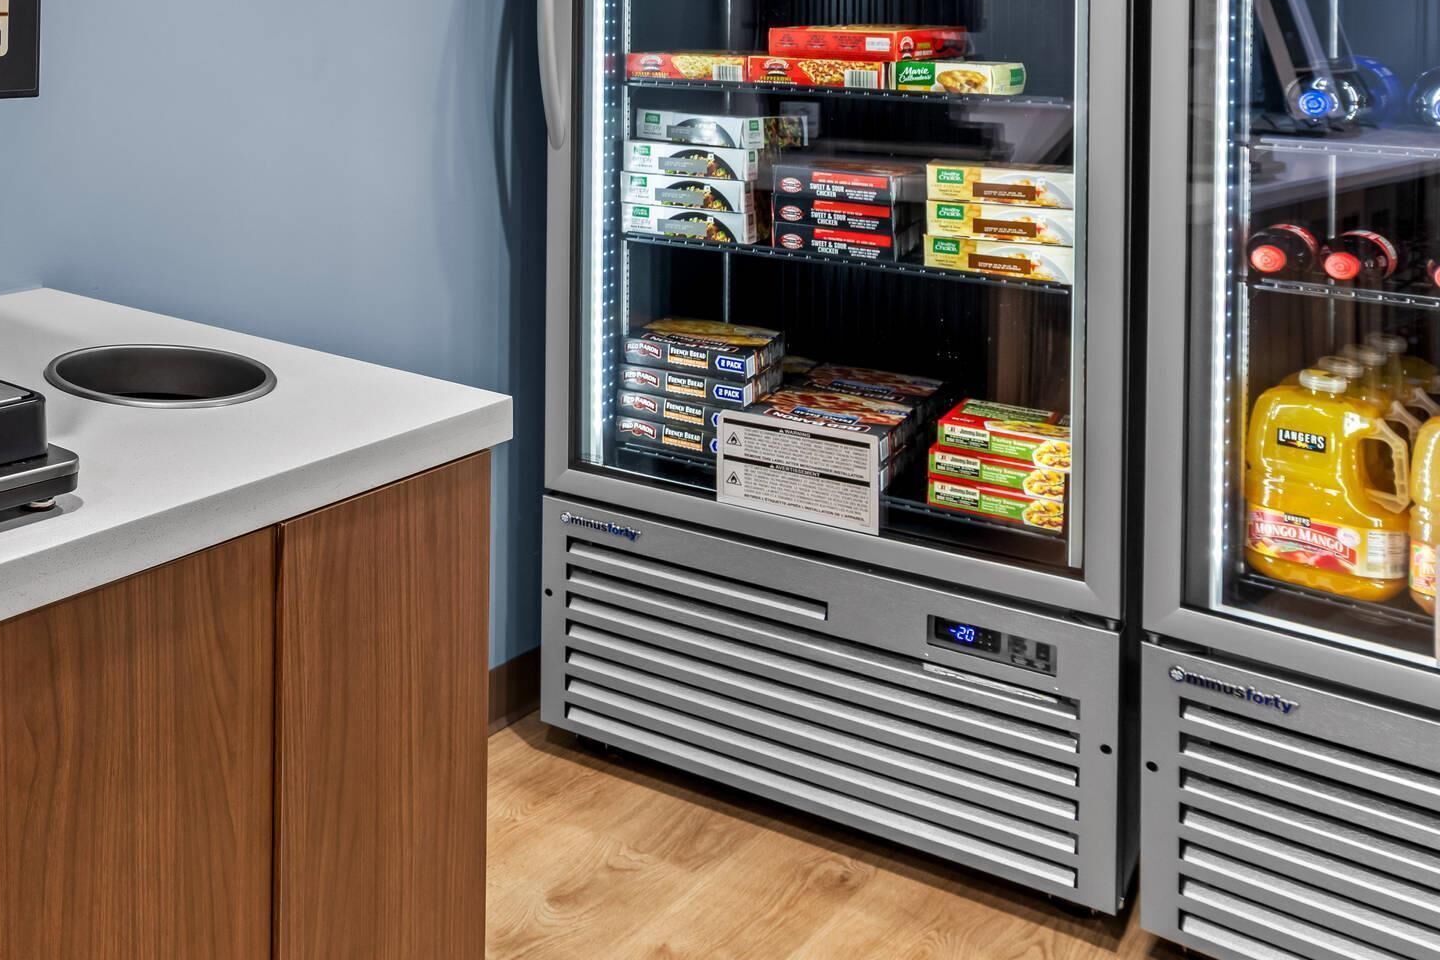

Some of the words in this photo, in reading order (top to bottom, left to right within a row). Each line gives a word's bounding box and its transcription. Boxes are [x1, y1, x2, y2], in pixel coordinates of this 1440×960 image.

[903, 67, 929, 75] Marie
[899, 73, 933, 83] Callender's
[816, 190, 837, 198] CHICKEN
[832, 185, 845, 193] SOUR
[811, 211, 827, 219] SWEET
[834, 213, 847, 221] SOUR
[817, 218, 839, 226] CHICKEN
[811, 239, 827, 247] SWEET
[834, 242, 847, 250] SOUR
[817, 247, 839, 255] CHICKEN
[639, 342, 659, 355] BARON
[670, 346, 689, 355] FRENCH
[689, 350, 707, 359] BREAD
[726, 360, 743, 371] PACK
[637, 370, 657, 384] BARON
[668, 375, 687, 384] FRENCH
[687, 378, 704, 388] BREAD
[723, 389, 740, 399] PACK
[635, 396, 655, 409] BARON
[666, 402, 685, 412] FRENCH
[685, 405, 702, 415] BREAD
[772, 410, 824, 427] BARON
[633, 422, 654, 435] BARON
[784, 429, 811, 439] WARNING
[826, 423, 863, 432] RED
[959, 428, 975, 437] Jimmy
[975, 430, 988, 438] Dean
[665, 428, 684, 437] FRENCH
[684, 431, 701, 441] BREAD
[1278, 429, 1326, 450] LANGERS
[991, 435, 1010, 444] Turkey
[1011, 439, 1037, 449] Sausage
[949, 456, 966, 465] Jimmy
[966, 458, 979, 466] Dean
[776, 464, 821, 478] AVERTISSEMENT
[981, 463, 1000, 471] Turkey
[1001, 468, 1027, 477] Sausage
[949, 486, 965, 494] Jimmy
[965, 488, 978, 496] Dean
[980, 493, 999, 502] Turkey
[1000, 498, 1026, 508] Sausage
[1284, 515, 1311, 527] LANGERS
[571, 515, 641, 542] minusforty
[1298, 530, 1345, 554] MANGO
[949, 626, 975, 642] -20
[1185, 670, 1298, 714] minusforty
